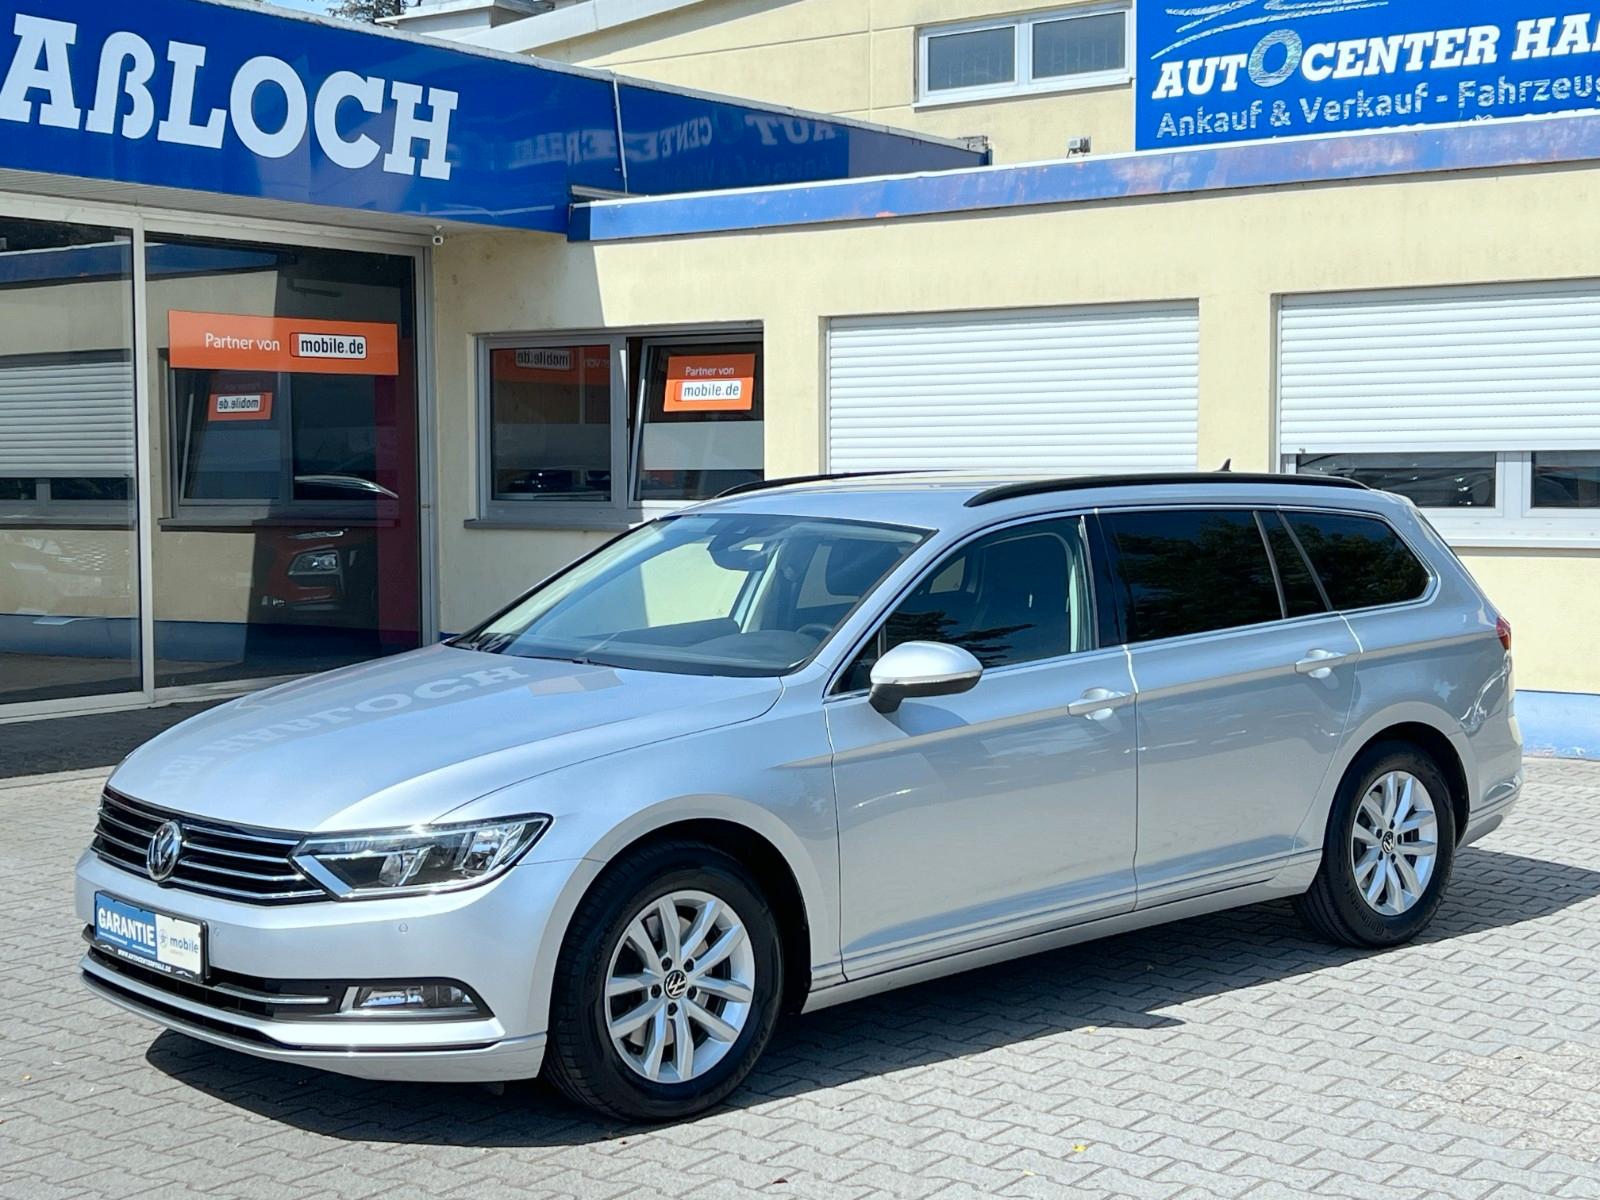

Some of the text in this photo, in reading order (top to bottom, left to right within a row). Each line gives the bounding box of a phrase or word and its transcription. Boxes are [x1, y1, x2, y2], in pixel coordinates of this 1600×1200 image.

[1152, 12, 1600, 99] AUTOCENTER HA
[0, 13, 458, 180] AßLOCH
[1157, 100, 1262, 139] Ankauf
[1270, 100, 1291, 127] &
[1300, 81, 1428, 123] Verkauf
[1458, 73, 1600, 109] Fahrzeu
[205, 332, 364, 355] Partner von mobile.de
[685, 366, 734, 377] Partner von
[684, 384, 739, 398] mobile.de
[98, 907, 156, 947] GARANTIE
[169, 937, 199, 954] mobile
